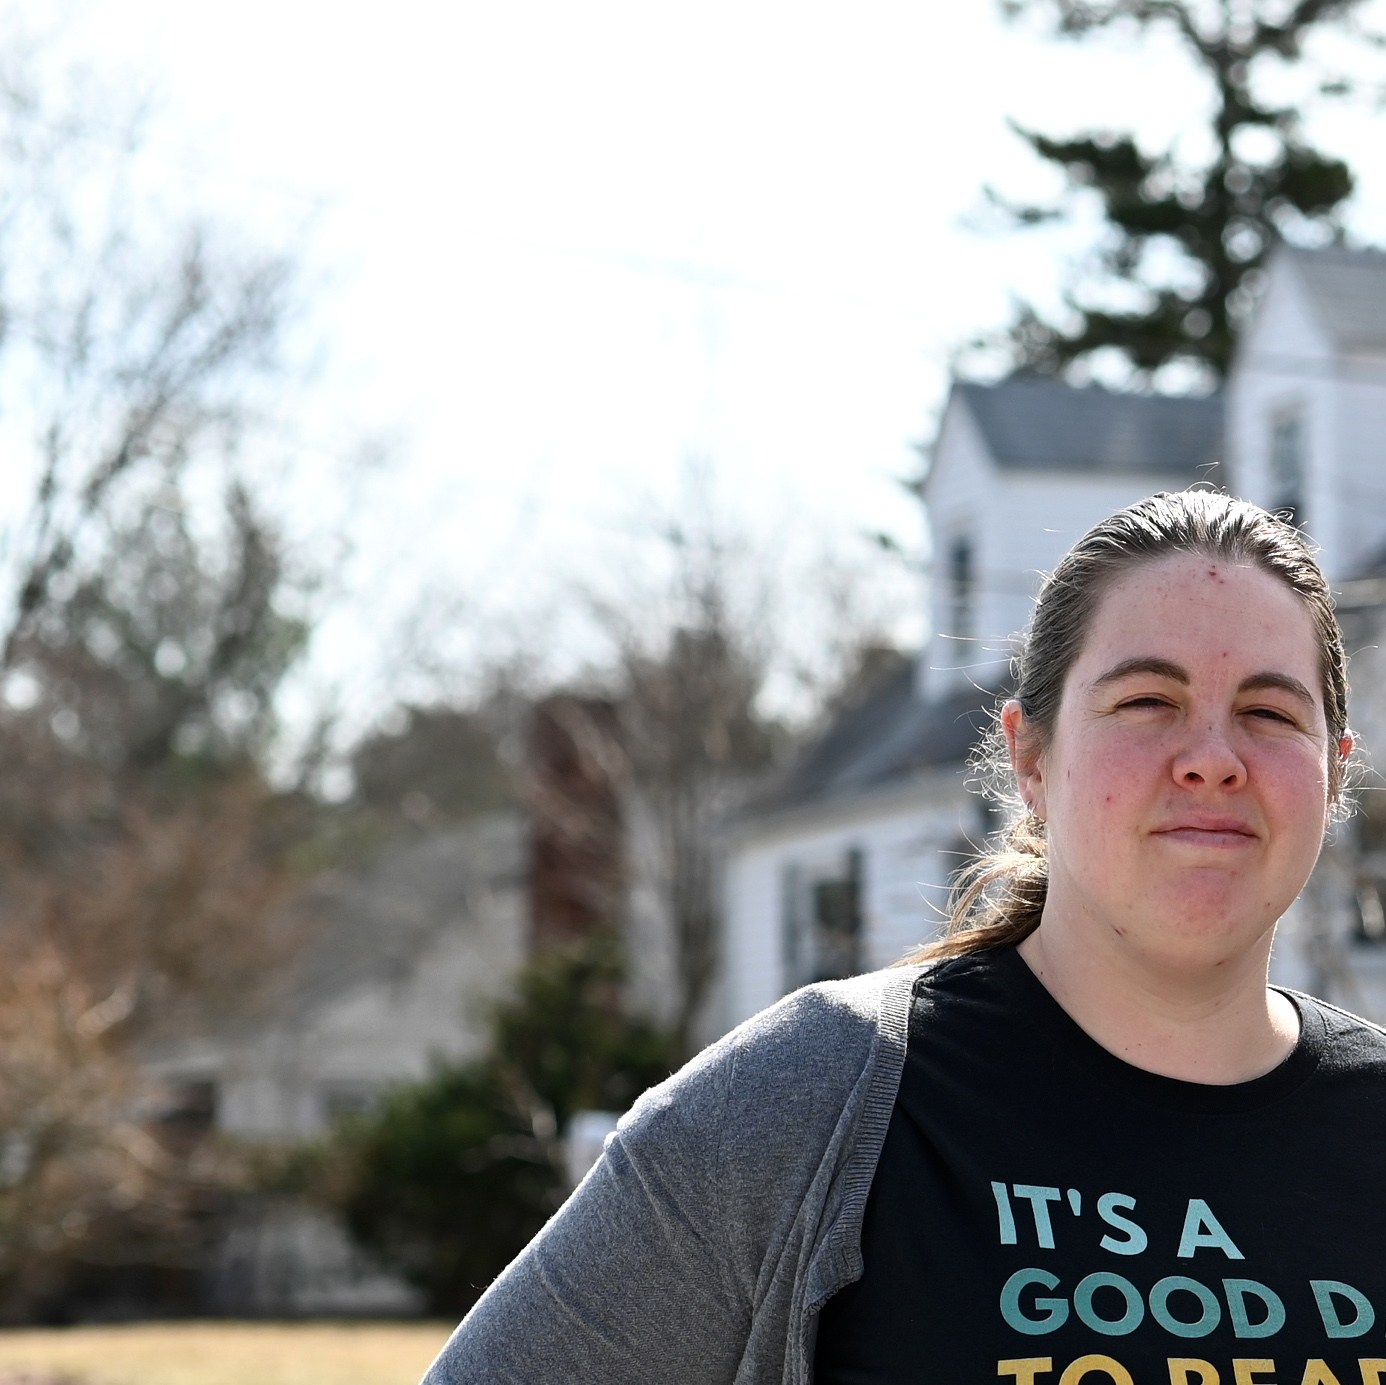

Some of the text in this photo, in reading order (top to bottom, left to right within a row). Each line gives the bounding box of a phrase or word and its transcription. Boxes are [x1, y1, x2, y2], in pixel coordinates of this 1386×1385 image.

[991, 1181, 1245, 1260] IT'S A
[1000, 1268, 1286, 1338] GOOD
